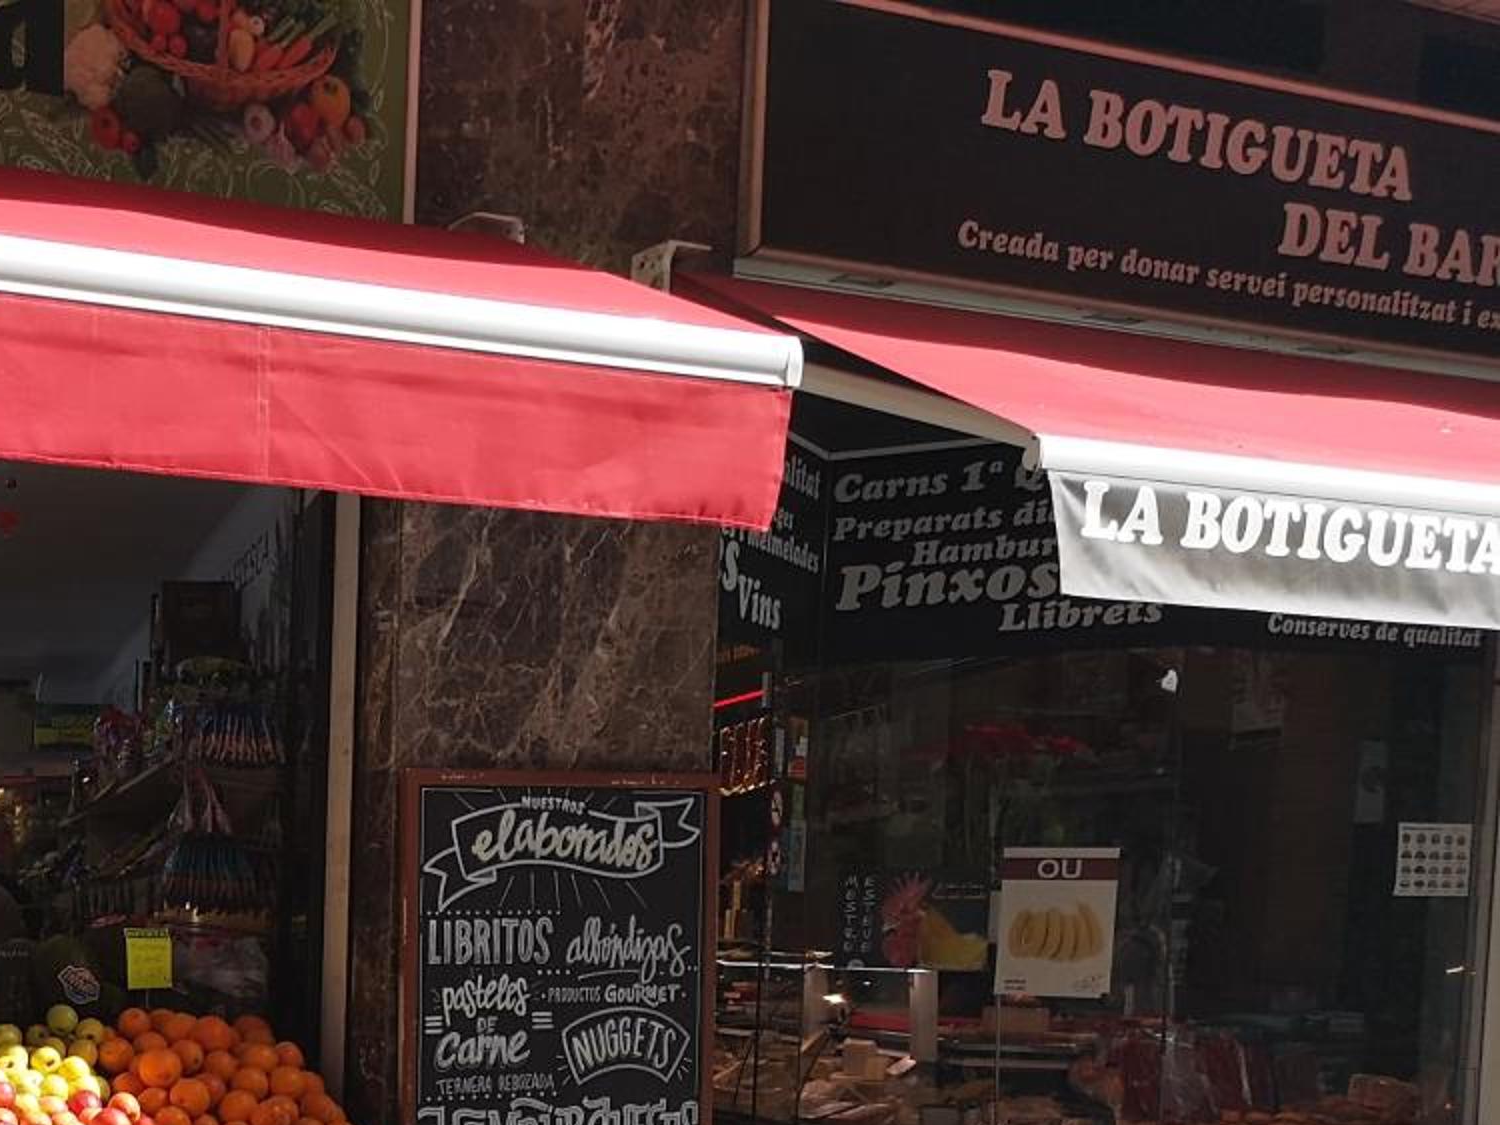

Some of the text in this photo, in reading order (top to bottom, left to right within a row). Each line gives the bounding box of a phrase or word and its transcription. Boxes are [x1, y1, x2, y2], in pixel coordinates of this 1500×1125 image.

[980, 69, 1413, 202] LA BOTIGUETA
[1277, 202, 1391, 272] DEL
[957, 220, 1060, 263] Creada
[1066, 242, 1115, 273] per
[1120, 248, 1200, 285] donar
[1205, 269, 1289, 299] servei
[1292, 281, 1457, 325] personalitzat
[833, 473, 949, 503] Carns
[832, 506, 1003, 541] Preparats
[1080, 480, 1500, 576] LA BOTIGUETA
[737, 574, 782, 631] Vins
[998, 600, 1165, 632] Llibrets
[1267, 613, 1483, 649] Conserves de qualitat
[520, 795, 587, 815] NUESTROS
[471, 809, 660, 871] elaborados
[1037, 858, 1083, 880] OU
[427, 916, 554, 966] LIBRITOS
[442, 974, 531, 1028] pasteles
[604, 983, 681, 1008] GOURMET
[476, 1016, 499, 1033] DE
[571, 1016, 678, 1072] NUGGETS
[434, 1030, 531, 1070] Carne
[435, 1076, 493, 1097] TERNERA
